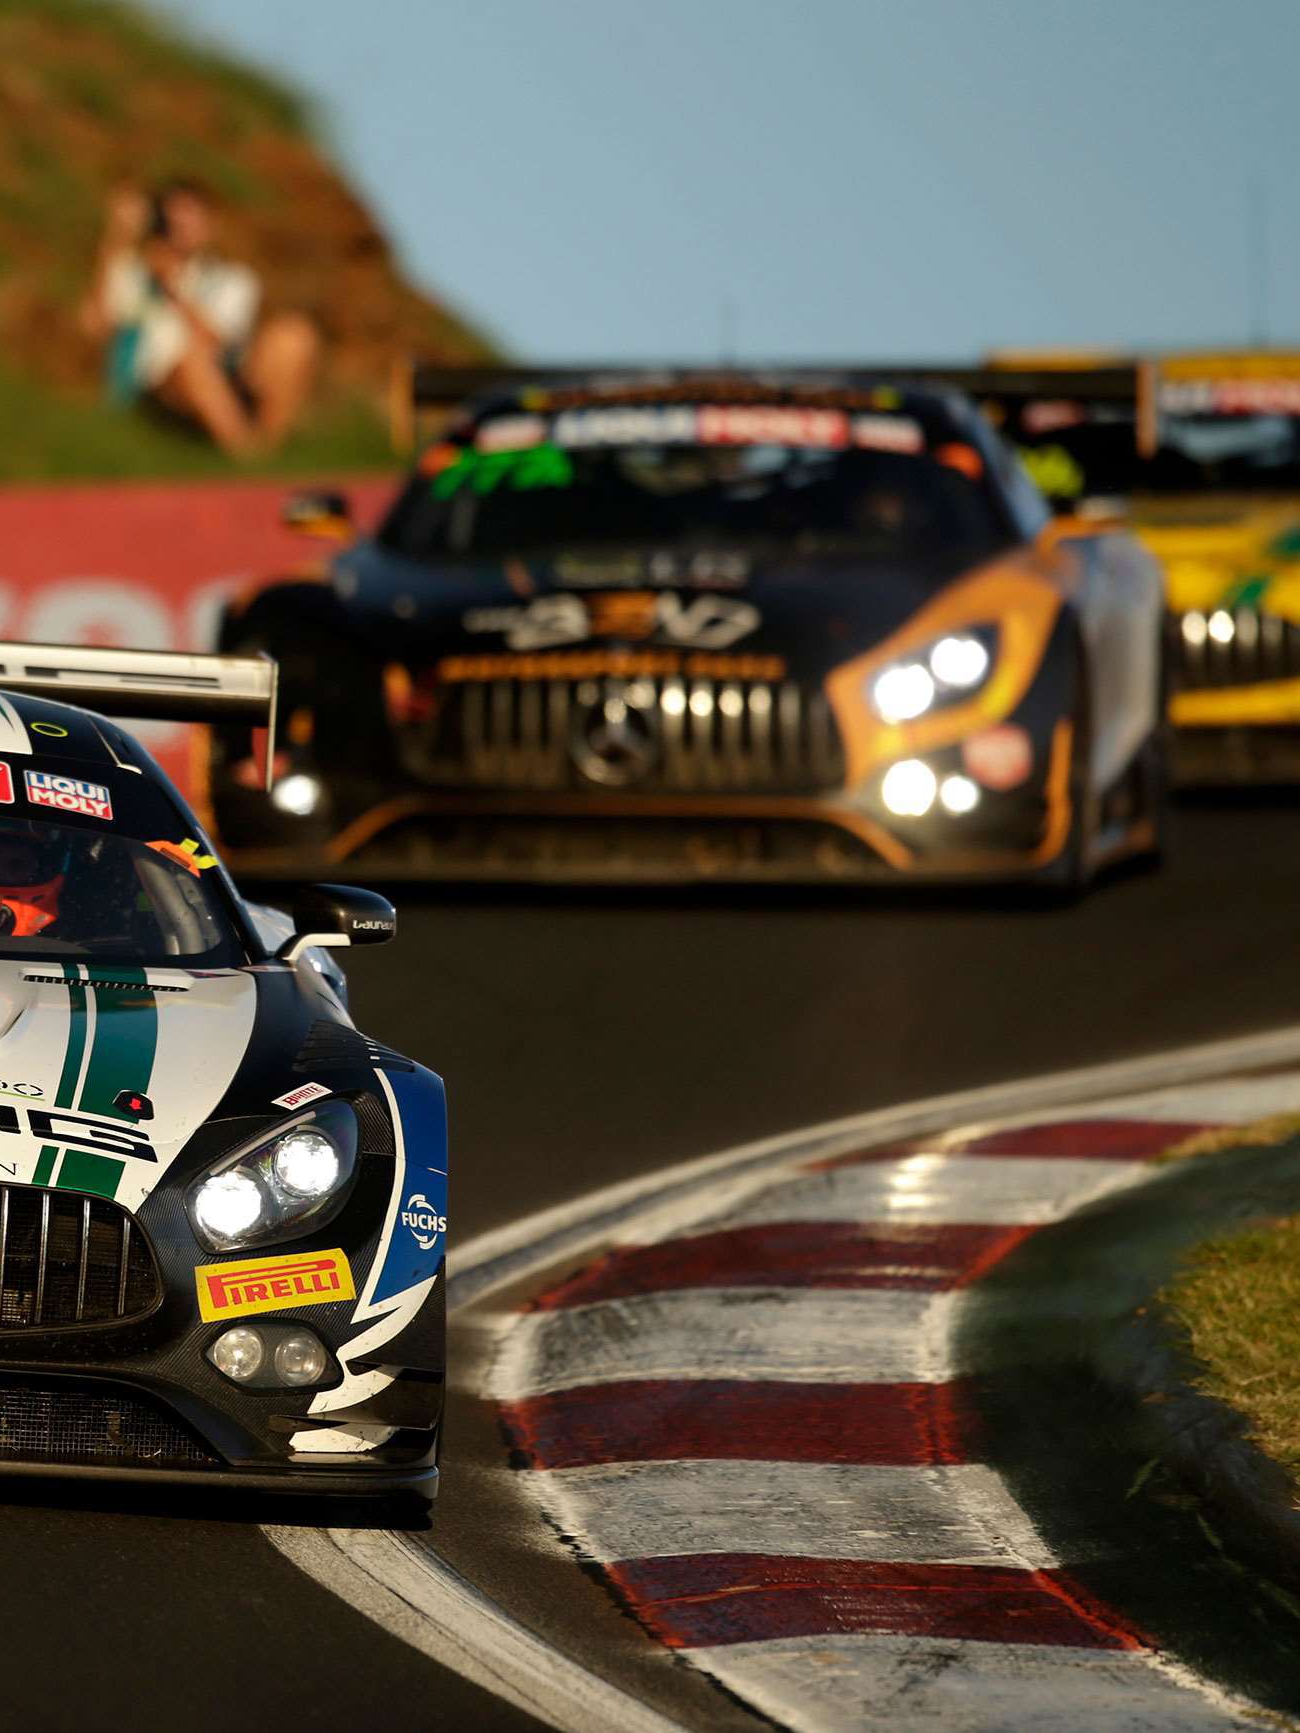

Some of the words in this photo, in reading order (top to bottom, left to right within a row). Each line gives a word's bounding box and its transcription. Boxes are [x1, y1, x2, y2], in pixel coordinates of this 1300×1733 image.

[28, 772, 107, 802] LIQUI
[33, 788, 109, 817] MOLY
[402, 1211, 447, 1233] FUCHS
[206, 1259, 341, 1309] PIRELLI
